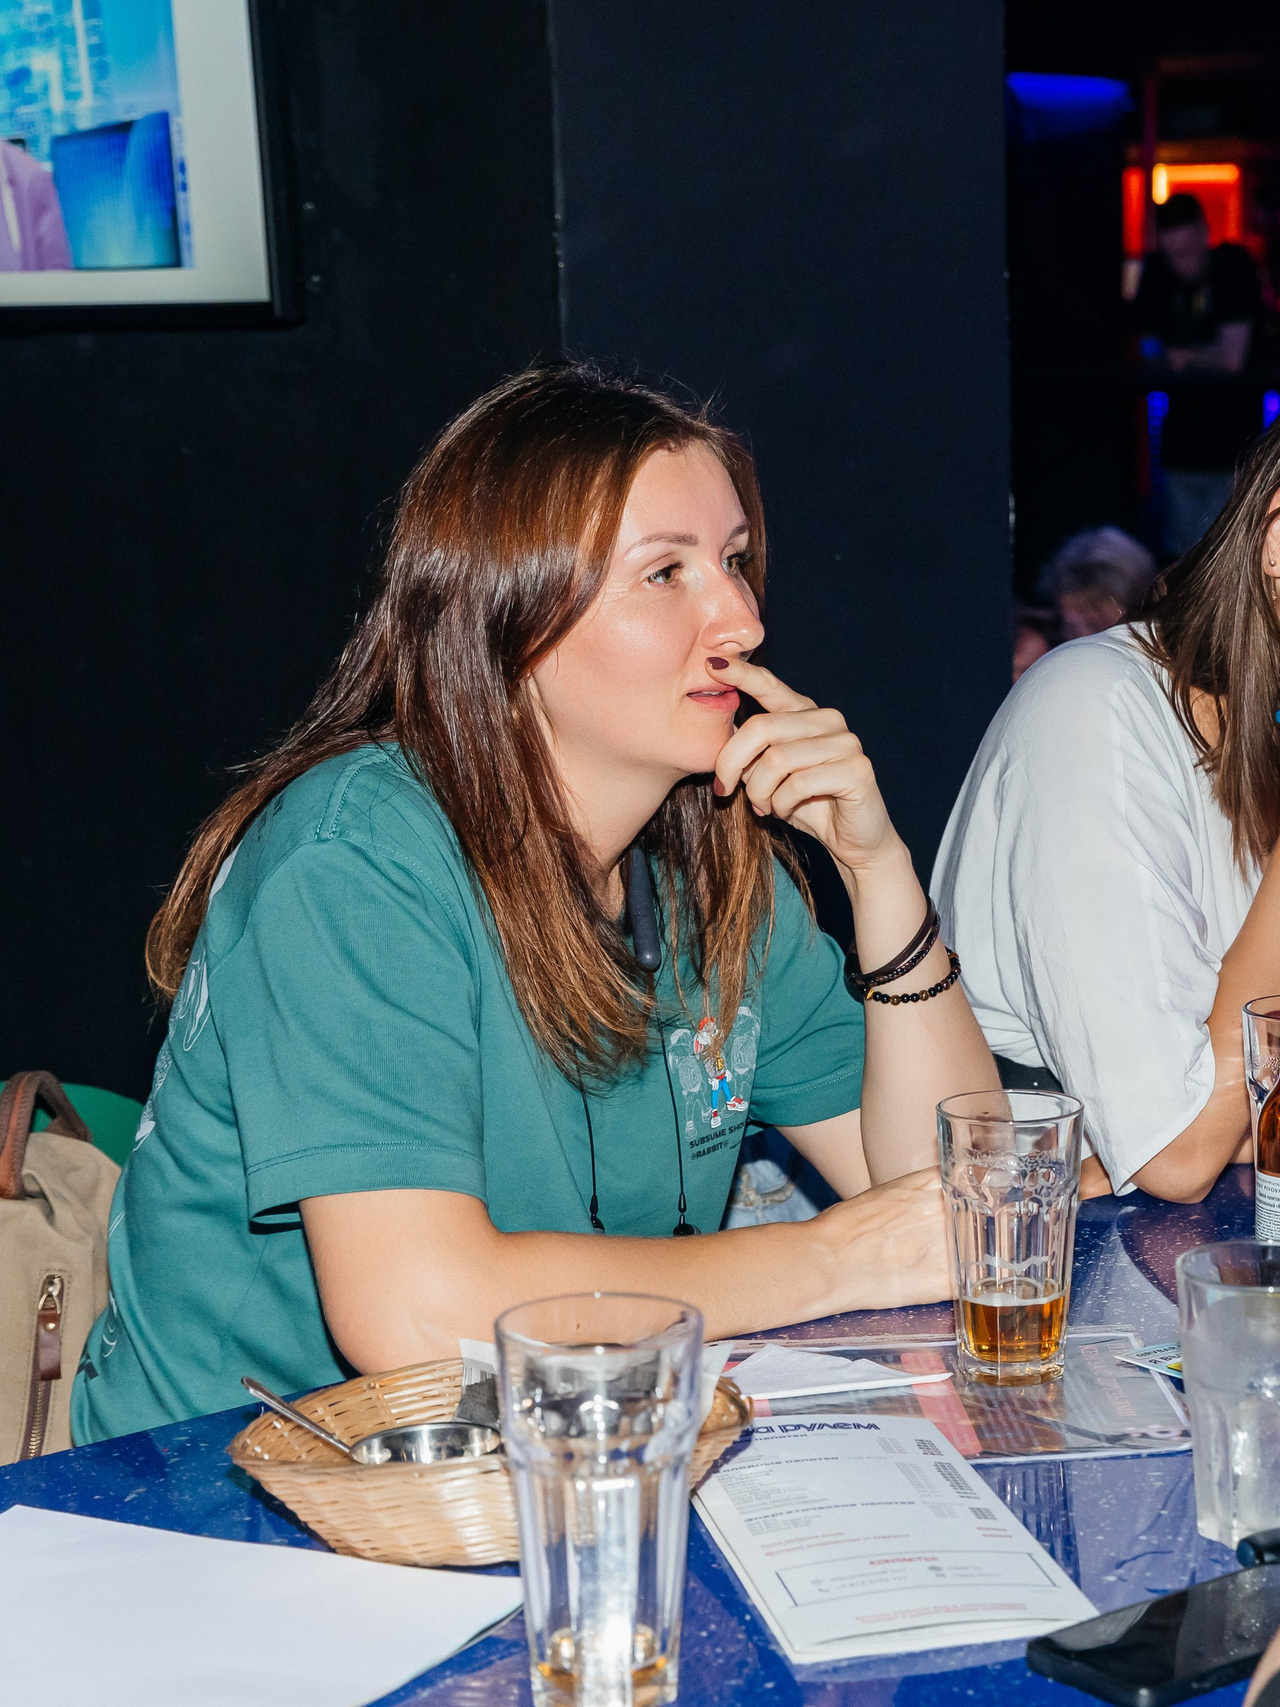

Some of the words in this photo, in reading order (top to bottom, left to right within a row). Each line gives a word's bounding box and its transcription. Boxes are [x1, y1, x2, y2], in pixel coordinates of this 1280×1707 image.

[689, 1128, 727, 1149] SUBSUME
[728, 1121, 745, 1134] SHO
[777, 1421, 881, 1434] рулем
